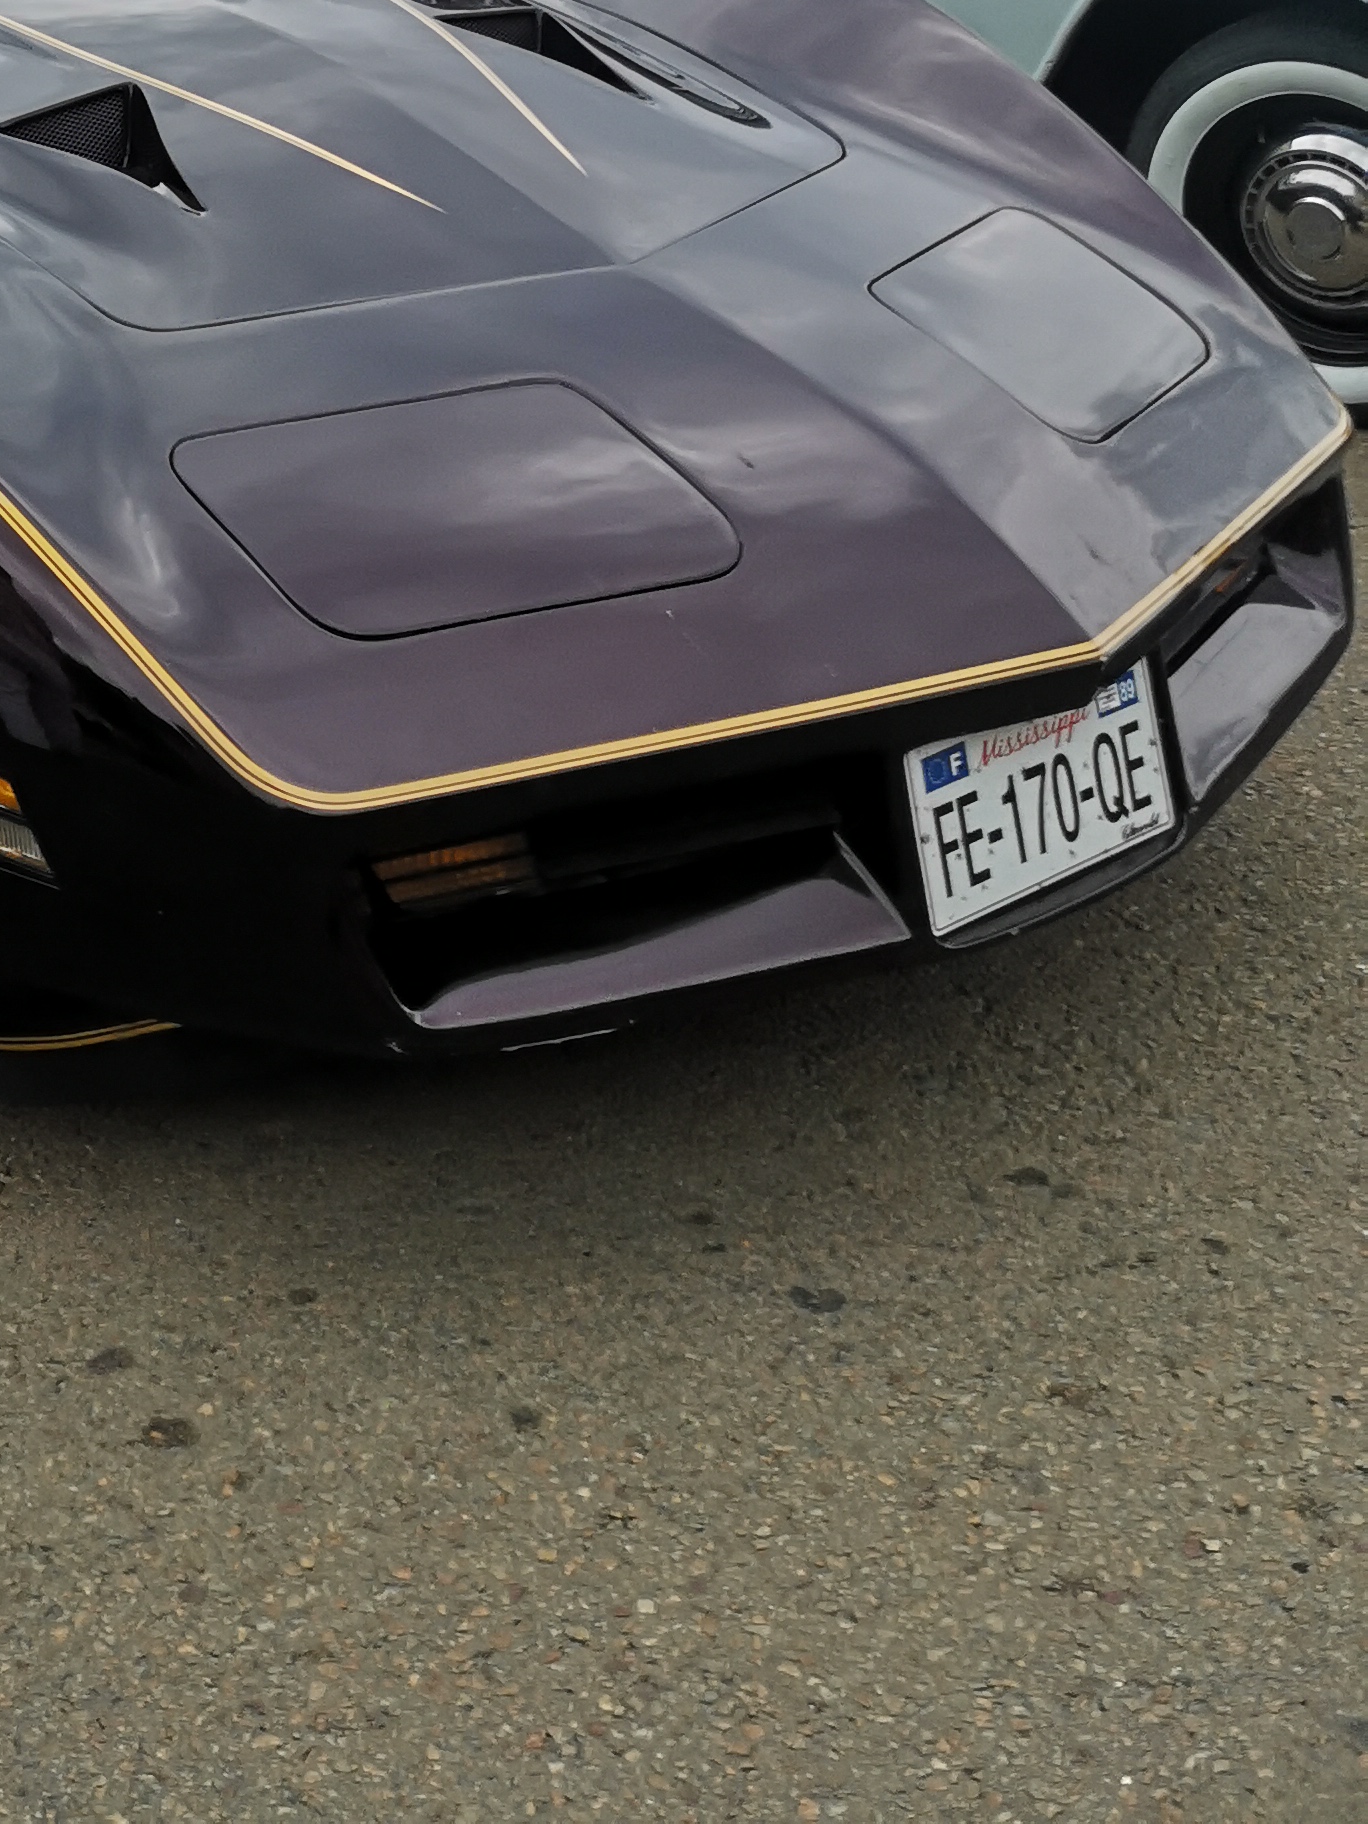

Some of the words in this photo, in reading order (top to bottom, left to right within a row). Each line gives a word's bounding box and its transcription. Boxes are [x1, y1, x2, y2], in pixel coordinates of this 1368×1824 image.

[1117, 678, 1135, 703] 89
[981, 705, 1092, 766] Mississippi
[947, 751, 966, 777] F
[932, 720, 1153, 898] FE-170-QE
